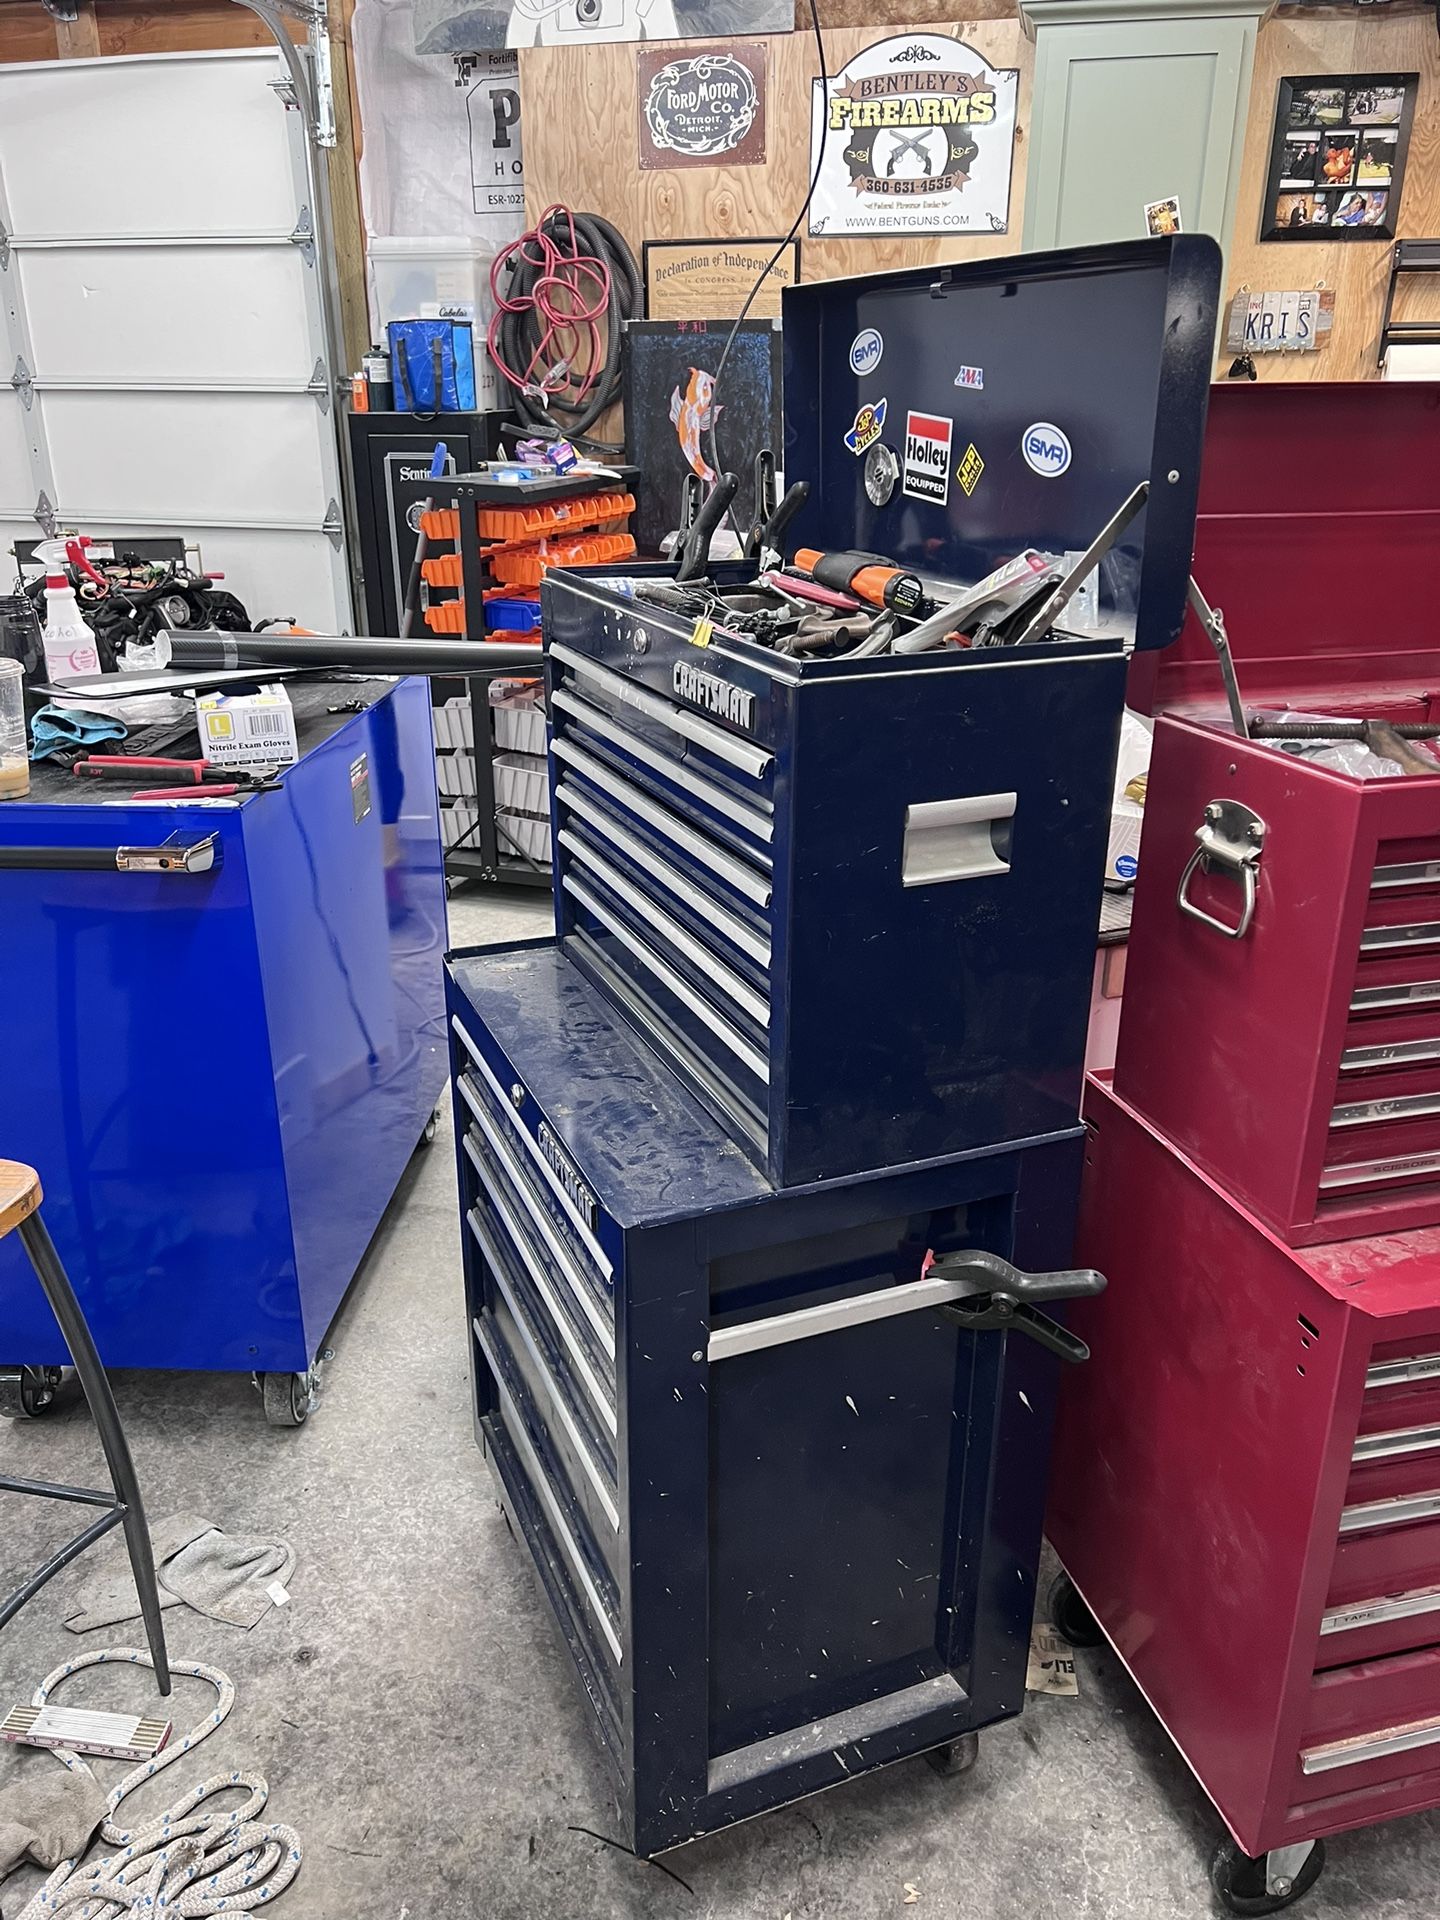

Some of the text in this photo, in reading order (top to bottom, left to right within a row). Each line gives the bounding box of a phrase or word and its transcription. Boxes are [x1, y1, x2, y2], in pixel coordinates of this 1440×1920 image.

[667, 82, 739, 113] FORD MOTOR
[861, 73, 968, 97] BENTLEY'S
[489, 88, 521, 148] P
[829, 92, 996, 129] FIREARMS
[866, 176, 952, 194] 360-631-4535
[845, 215, 970, 227] WWW.BENTGUNS.COM
[655, 256, 710, 282] Declaration
[1246, 311, 1310, 340] KRIS
[854, 339, 878, 364] SMR
[955, 367, 982, 386] AMA
[855, 416, 880, 451] CYCLES
[906, 436, 948, 475] Holley
[1029, 436, 1064, 463] SMR
[906, 475, 945, 493] EQUIPPED
[673, 661, 753, 730] CRAFTSMAN
[208, 743, 237, 752] Nitrile
[239, 742, 261, 750] Exam
[1373, 1159, 1436, 1172] SCISSORS
